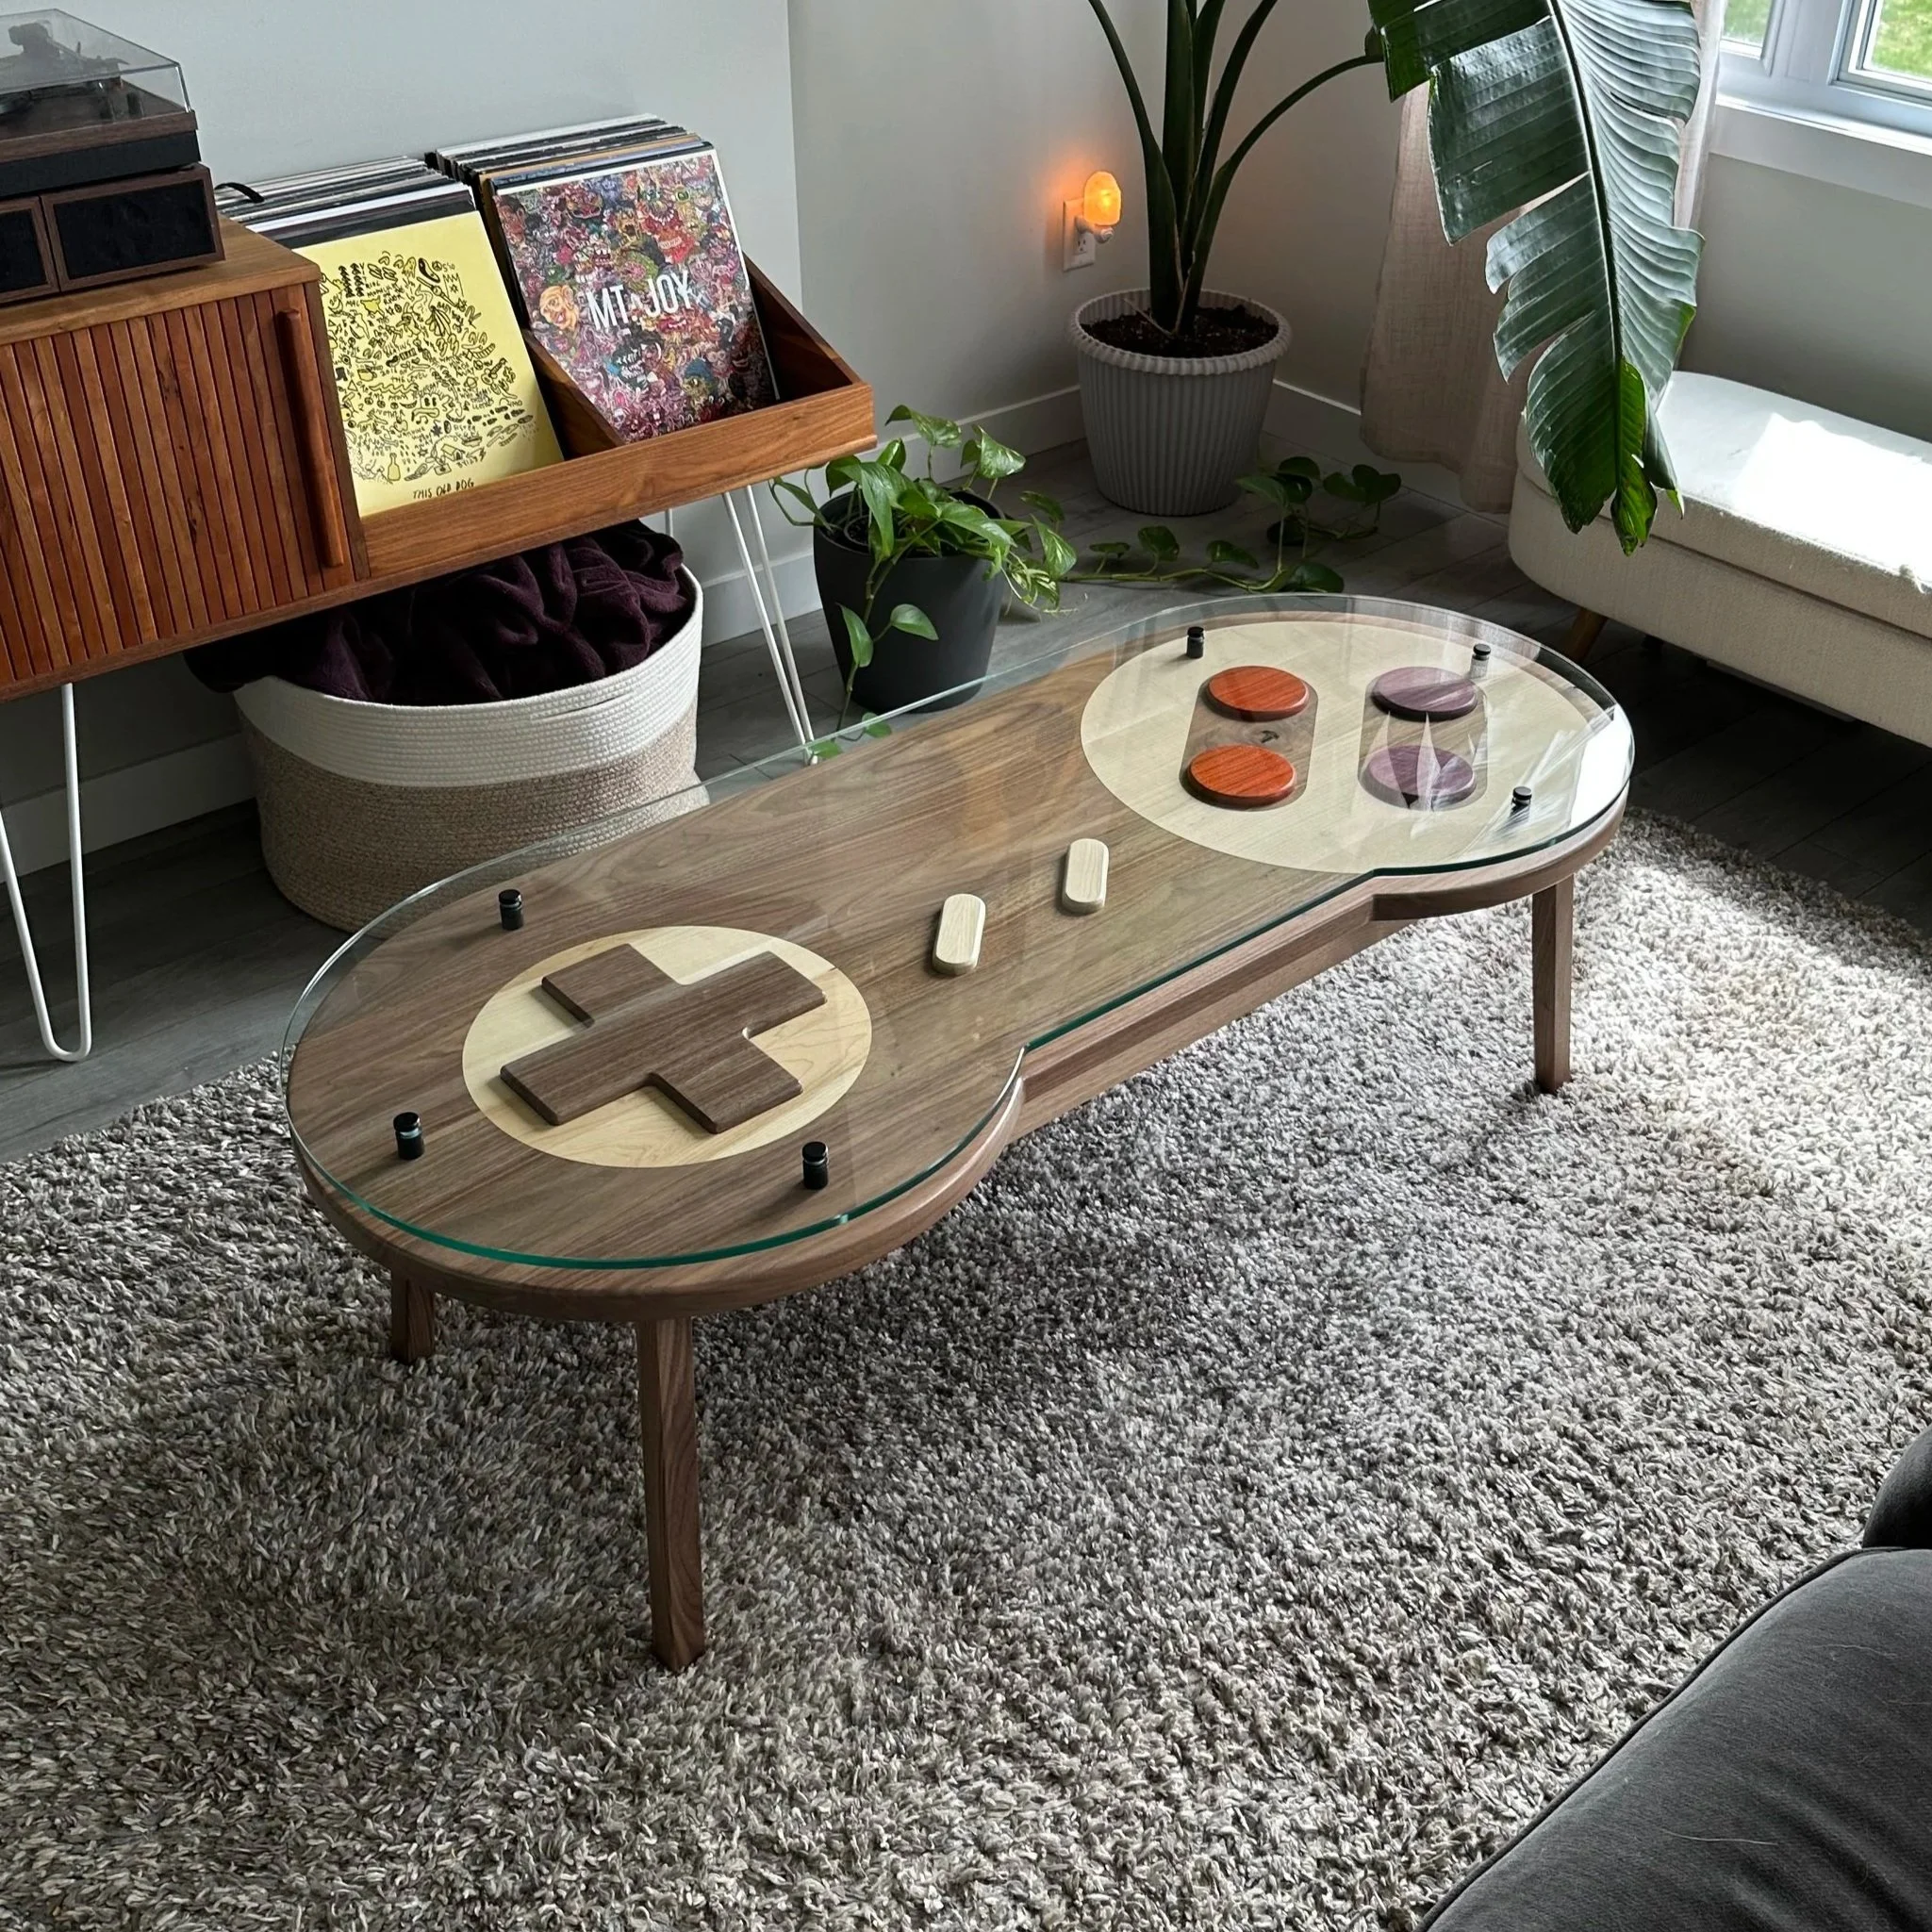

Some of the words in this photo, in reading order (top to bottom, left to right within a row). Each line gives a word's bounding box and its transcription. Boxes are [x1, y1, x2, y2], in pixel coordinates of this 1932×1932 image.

[645, 270, 692, 318] JOY
[413, 487, 433, 500] THIS
[436, 482, 452, 497] OLD
[455, 477, 474, 491] DOG
